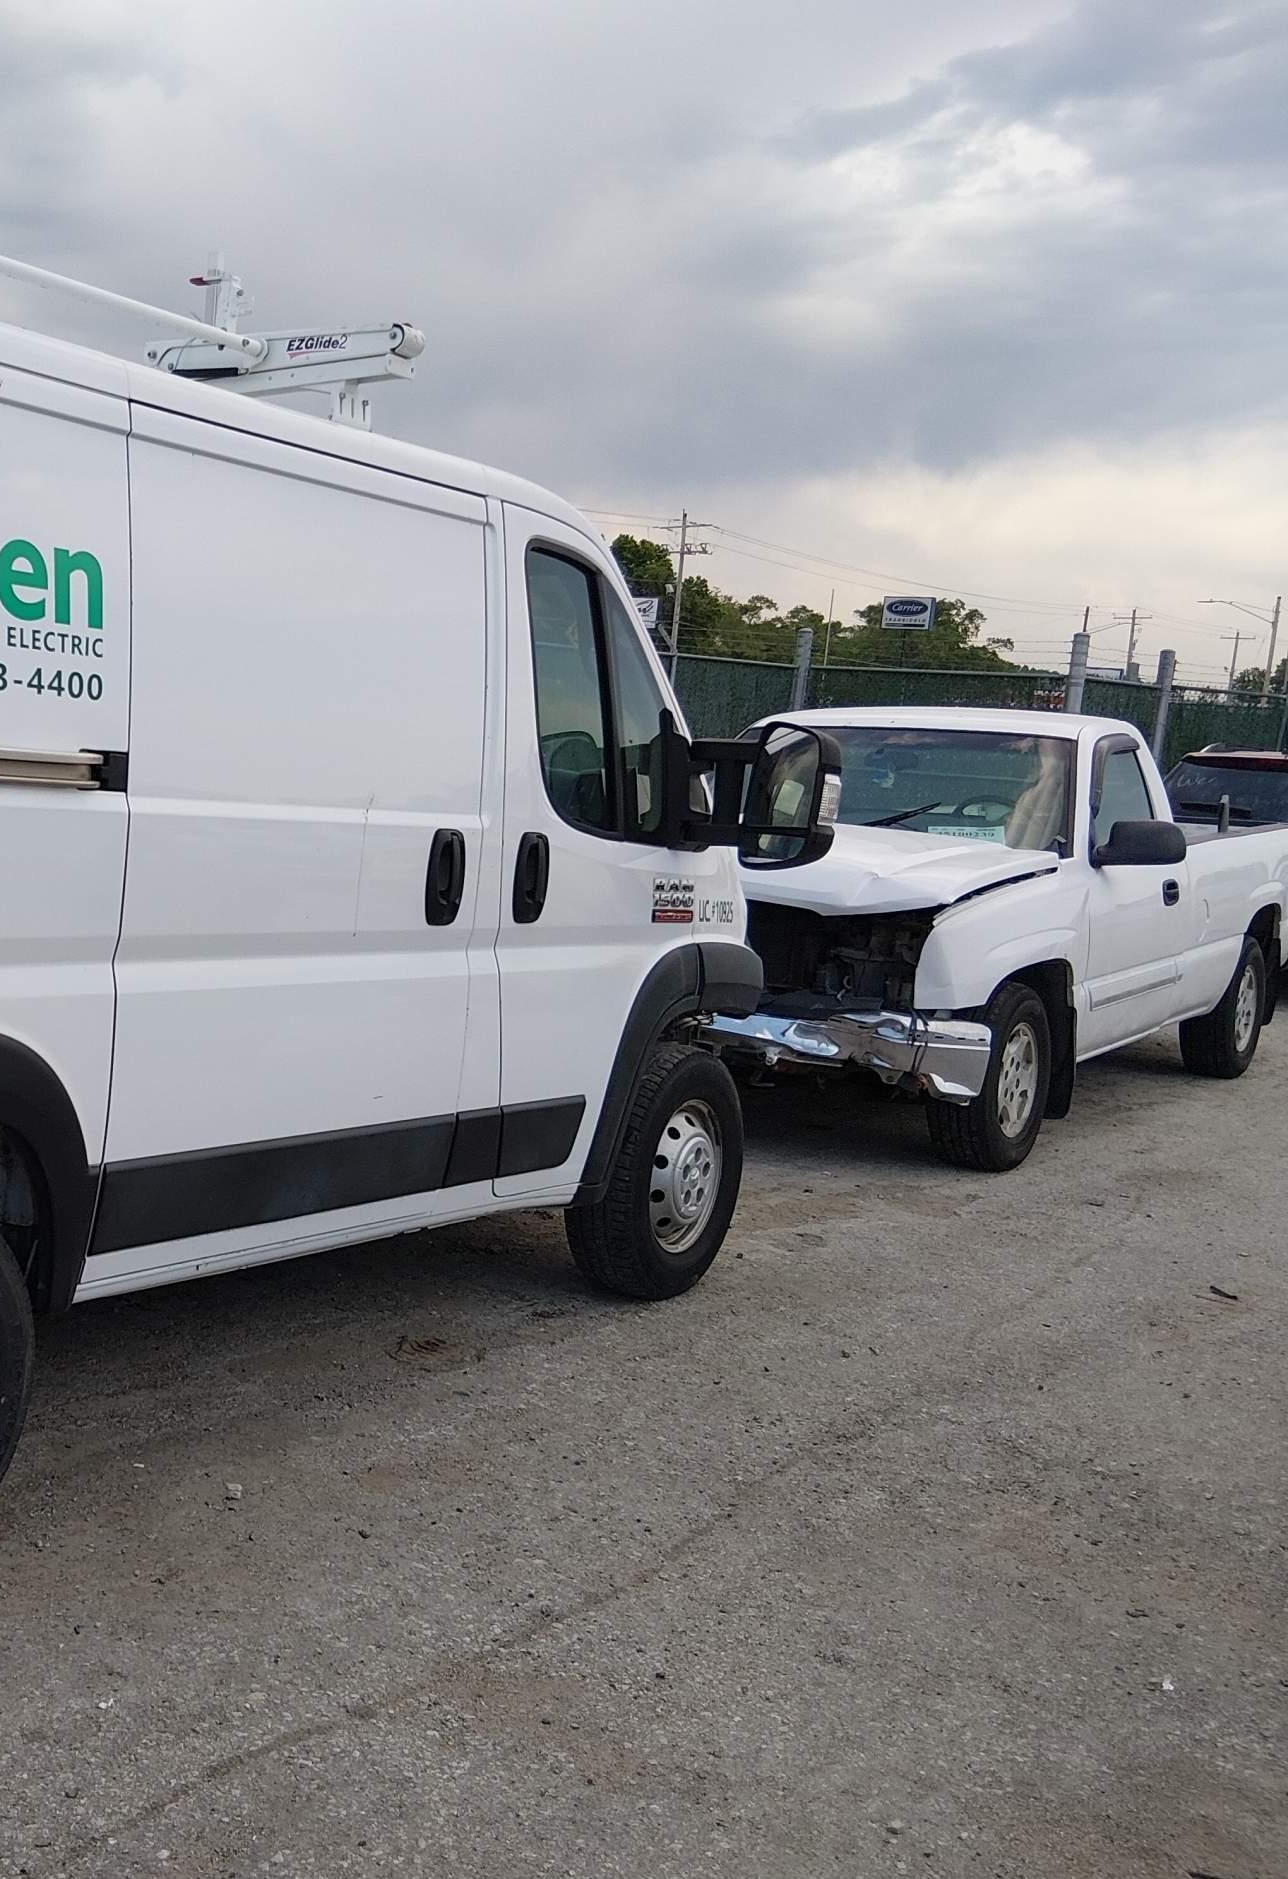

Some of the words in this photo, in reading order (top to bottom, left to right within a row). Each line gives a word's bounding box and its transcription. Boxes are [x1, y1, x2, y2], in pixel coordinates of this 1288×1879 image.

[286, 334, 348, 352] EZGlide2
[892, 603, 923, 612] Carrier
[6, 626, 104, 658] ELECTRIC
